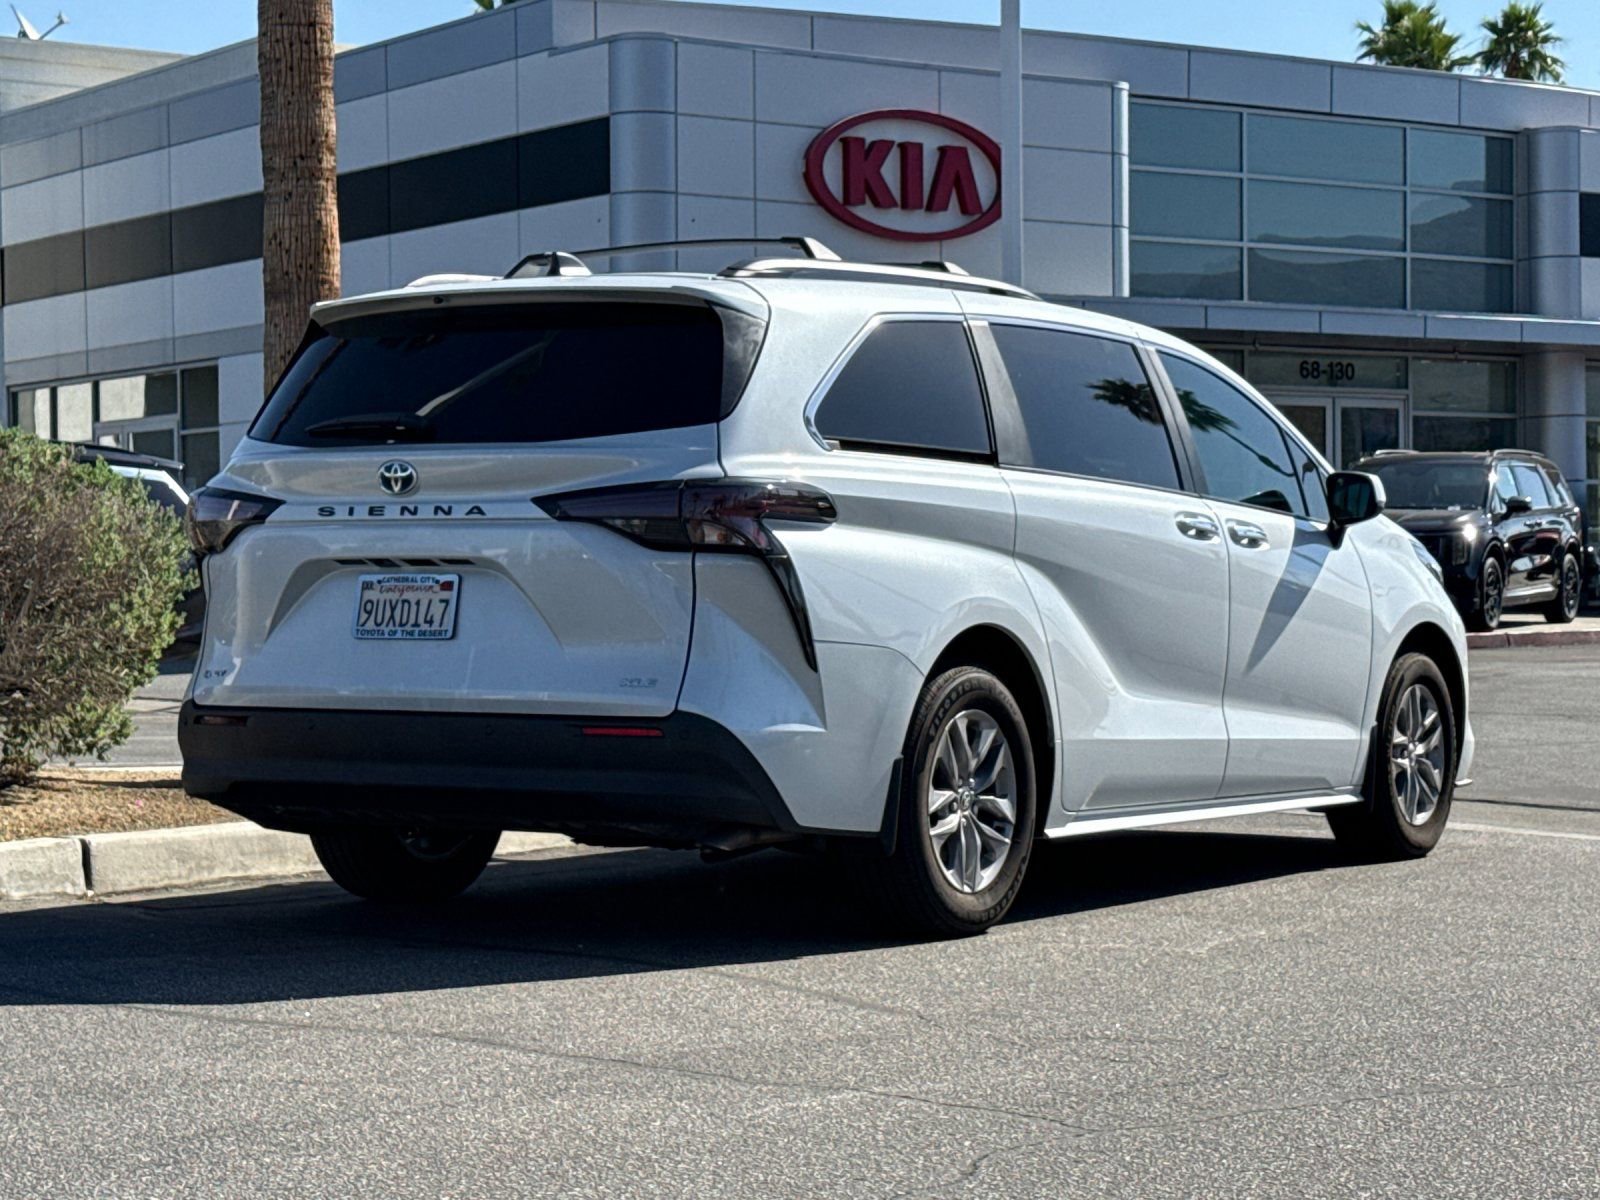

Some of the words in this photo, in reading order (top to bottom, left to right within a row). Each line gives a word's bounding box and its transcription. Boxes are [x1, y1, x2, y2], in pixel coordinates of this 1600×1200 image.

[840, 136, 983, 216] KIA
[1299, 360, 1355, 381] 68-130
[317, 505, 487, 517] SIENNA
[382, 576, 418, 584] CATHEDRAL
[360, 598, 450, 628] 9UXD147
